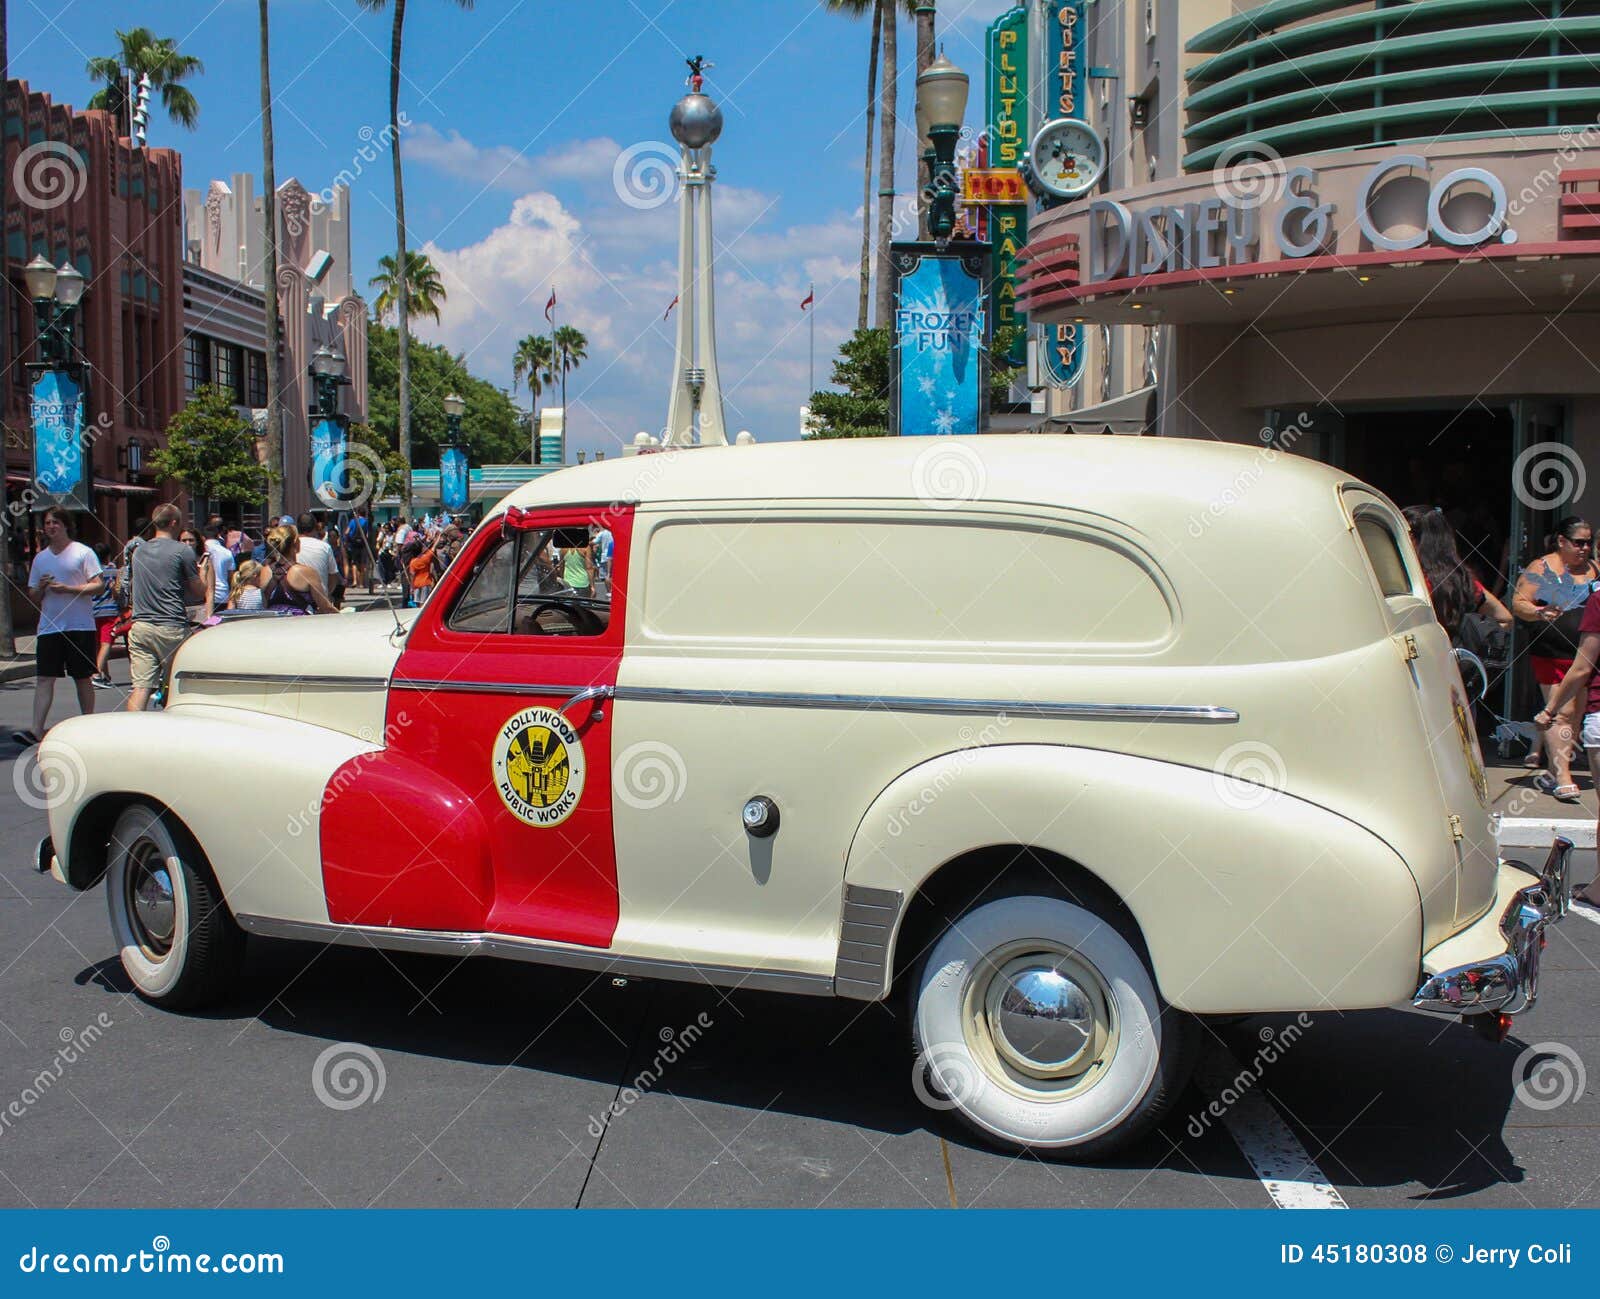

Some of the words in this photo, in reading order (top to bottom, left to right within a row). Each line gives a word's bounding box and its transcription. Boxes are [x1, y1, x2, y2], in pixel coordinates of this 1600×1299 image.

[1058, 6, 1077, 114] GIFTS
[968, 176, 1022, 195] TOY
[1089, 193, 1259, 283] DISNEY
[1276, 167, 1336, 257] &
[895, 309, 985, 333] FROZEN
[918, 331, 963, 351] FUN
[31, 403, 82, 418] FROZEN
[503, 710, 575, 745] HOLLYWOOD
[501, 782, 534, 820] PUBLIC
[537, 789, 577, 822] WORKS
